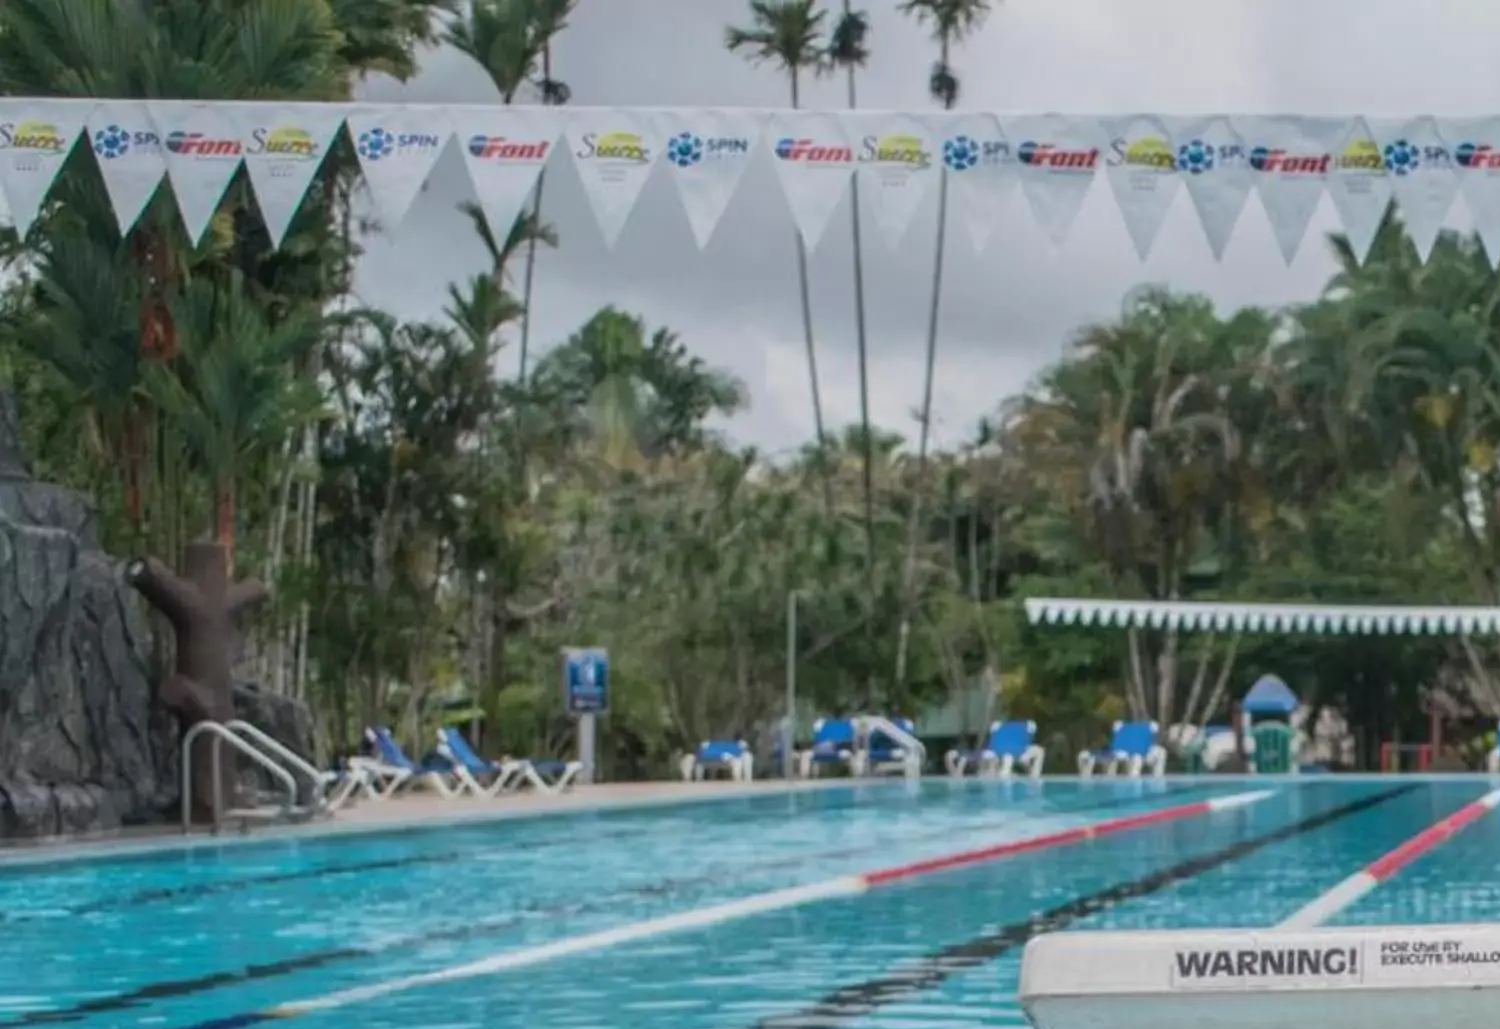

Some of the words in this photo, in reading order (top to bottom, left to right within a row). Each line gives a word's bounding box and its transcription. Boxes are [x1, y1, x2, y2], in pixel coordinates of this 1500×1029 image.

[398, 134, 438, 148] SPIN
[706, 138, 747, 152] SPIN
[1380, 941, 1408, 953] FOR
[1176, 946, 1357, 977] WARNING!
[1380, 952, 1442, 966] EXECUTE
